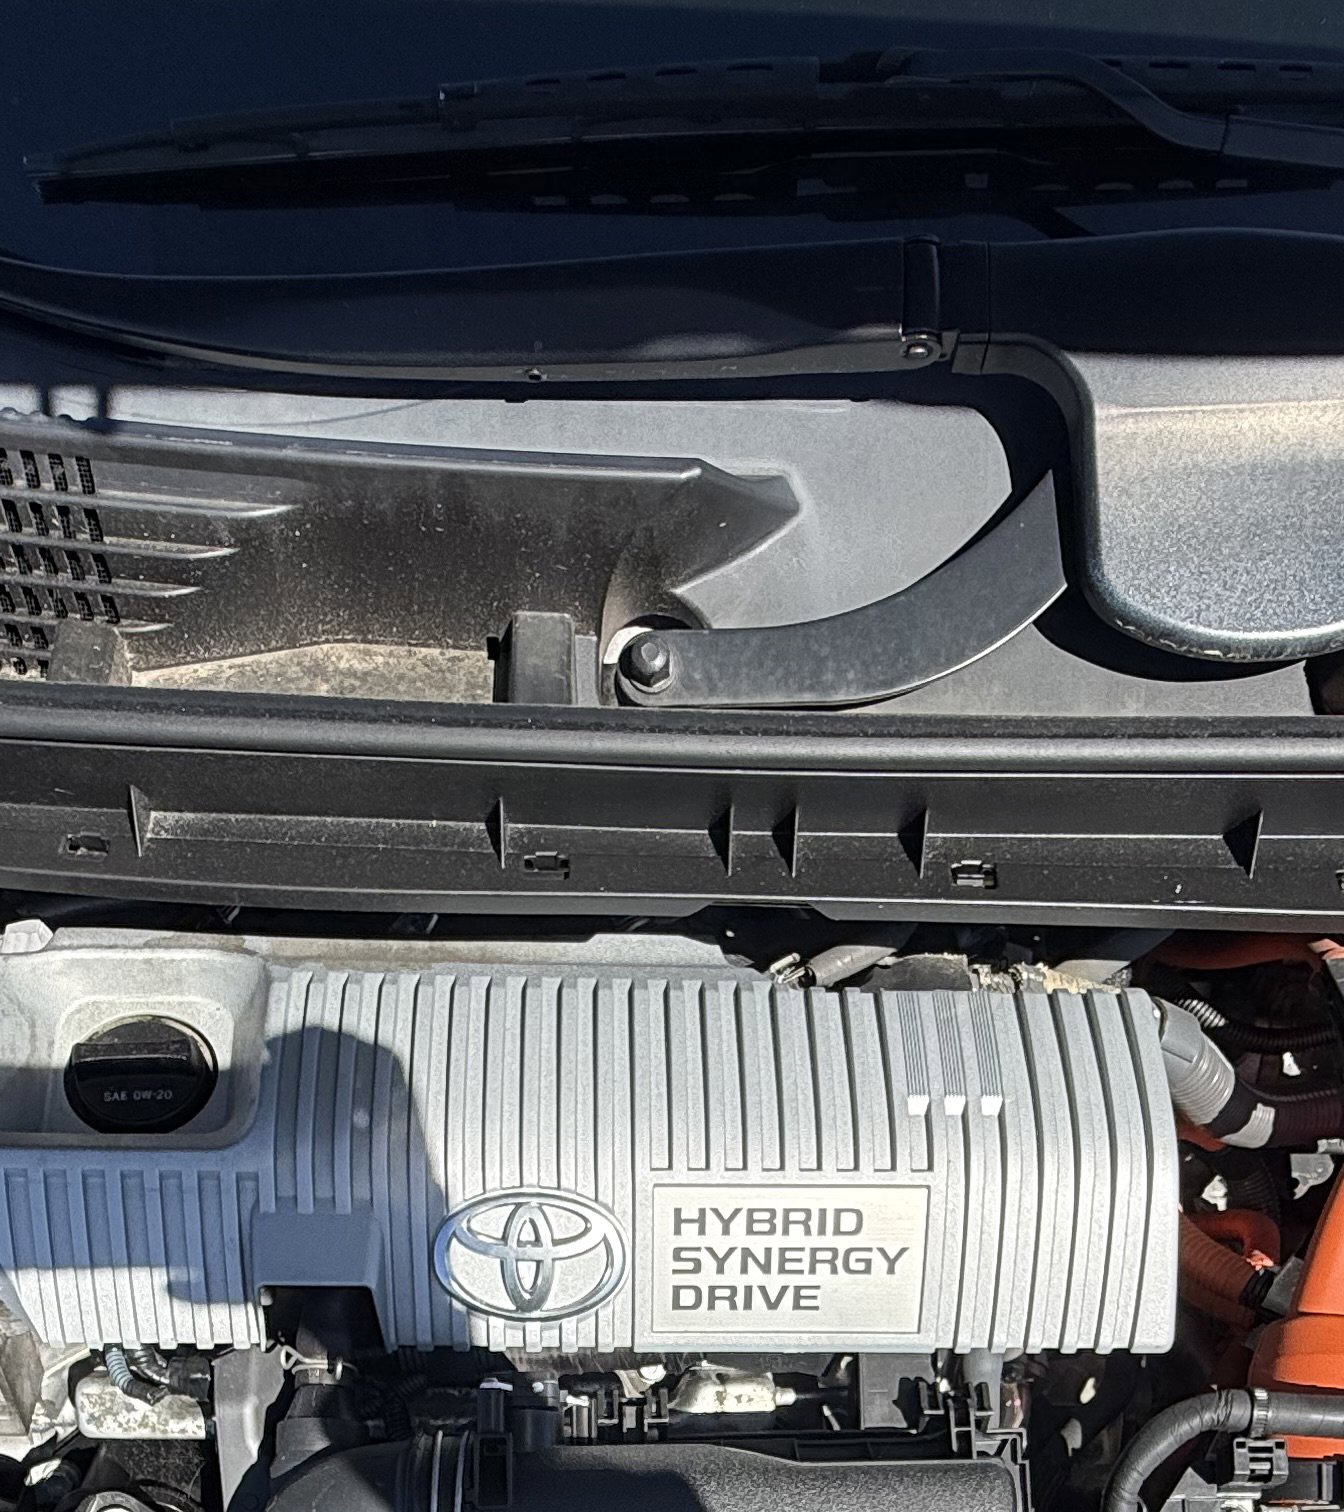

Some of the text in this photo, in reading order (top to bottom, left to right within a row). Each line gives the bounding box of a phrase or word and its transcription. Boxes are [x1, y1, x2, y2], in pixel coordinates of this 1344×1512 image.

[104, 1089, 173, 1102] SAE 0W-20
[672, 1207, 863, 1237] HYBRID
[671, 1246, 910, 1276] SYNERGY
[671, 1284, 821, 1312] DRIVE
